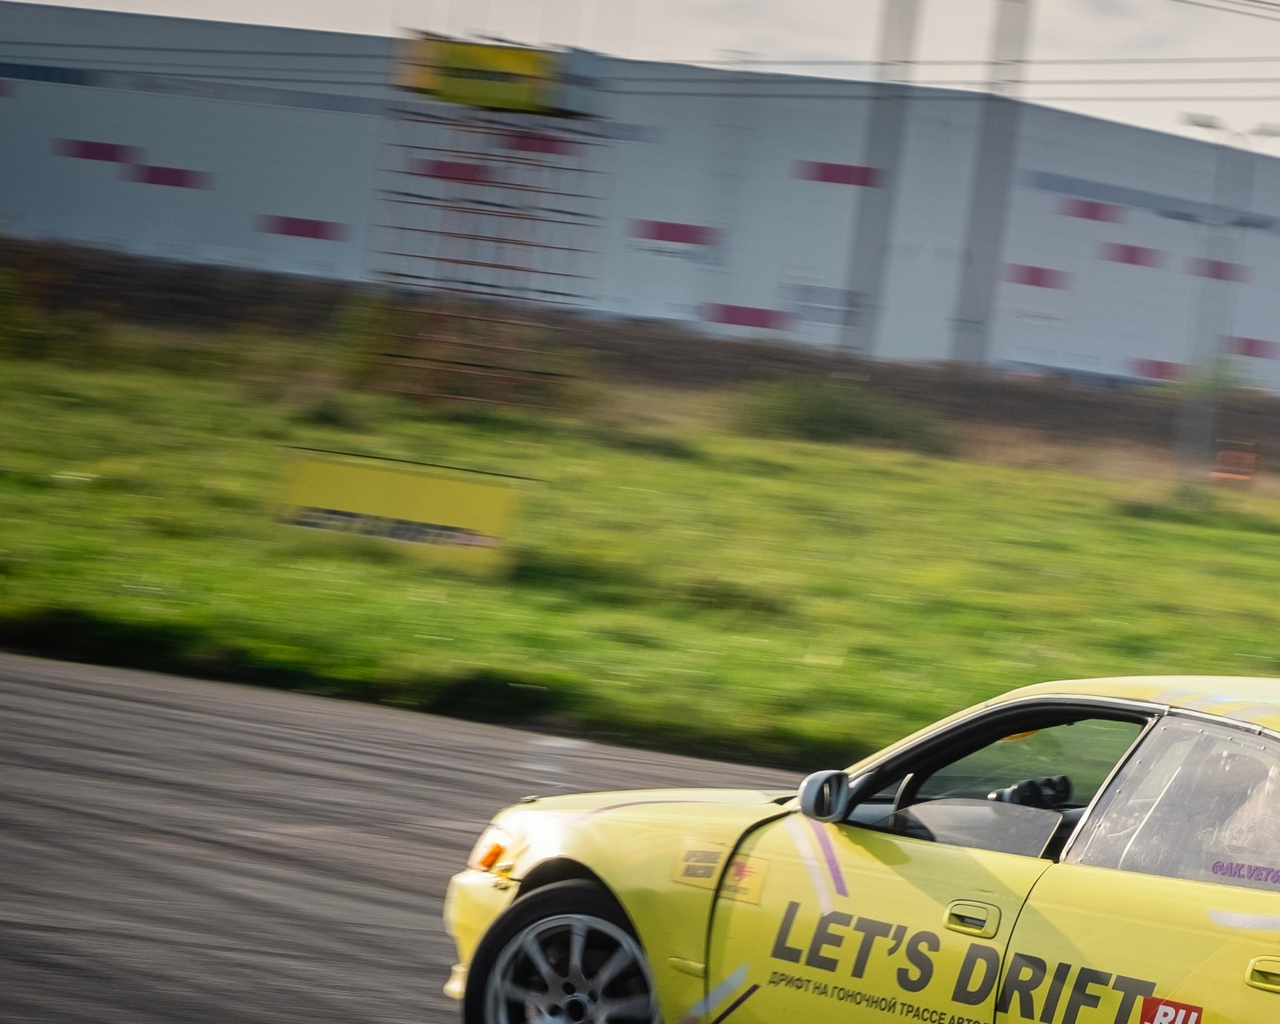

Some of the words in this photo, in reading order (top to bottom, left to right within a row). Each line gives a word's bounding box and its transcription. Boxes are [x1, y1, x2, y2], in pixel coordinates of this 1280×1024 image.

[770, 901, 941, 993] LET'S
[767, 971, 812, 991] ДРИФТ
[812, 981, 829, 997] НА
[830, 985, 898, 1014] ГОНОЧНОЙ
